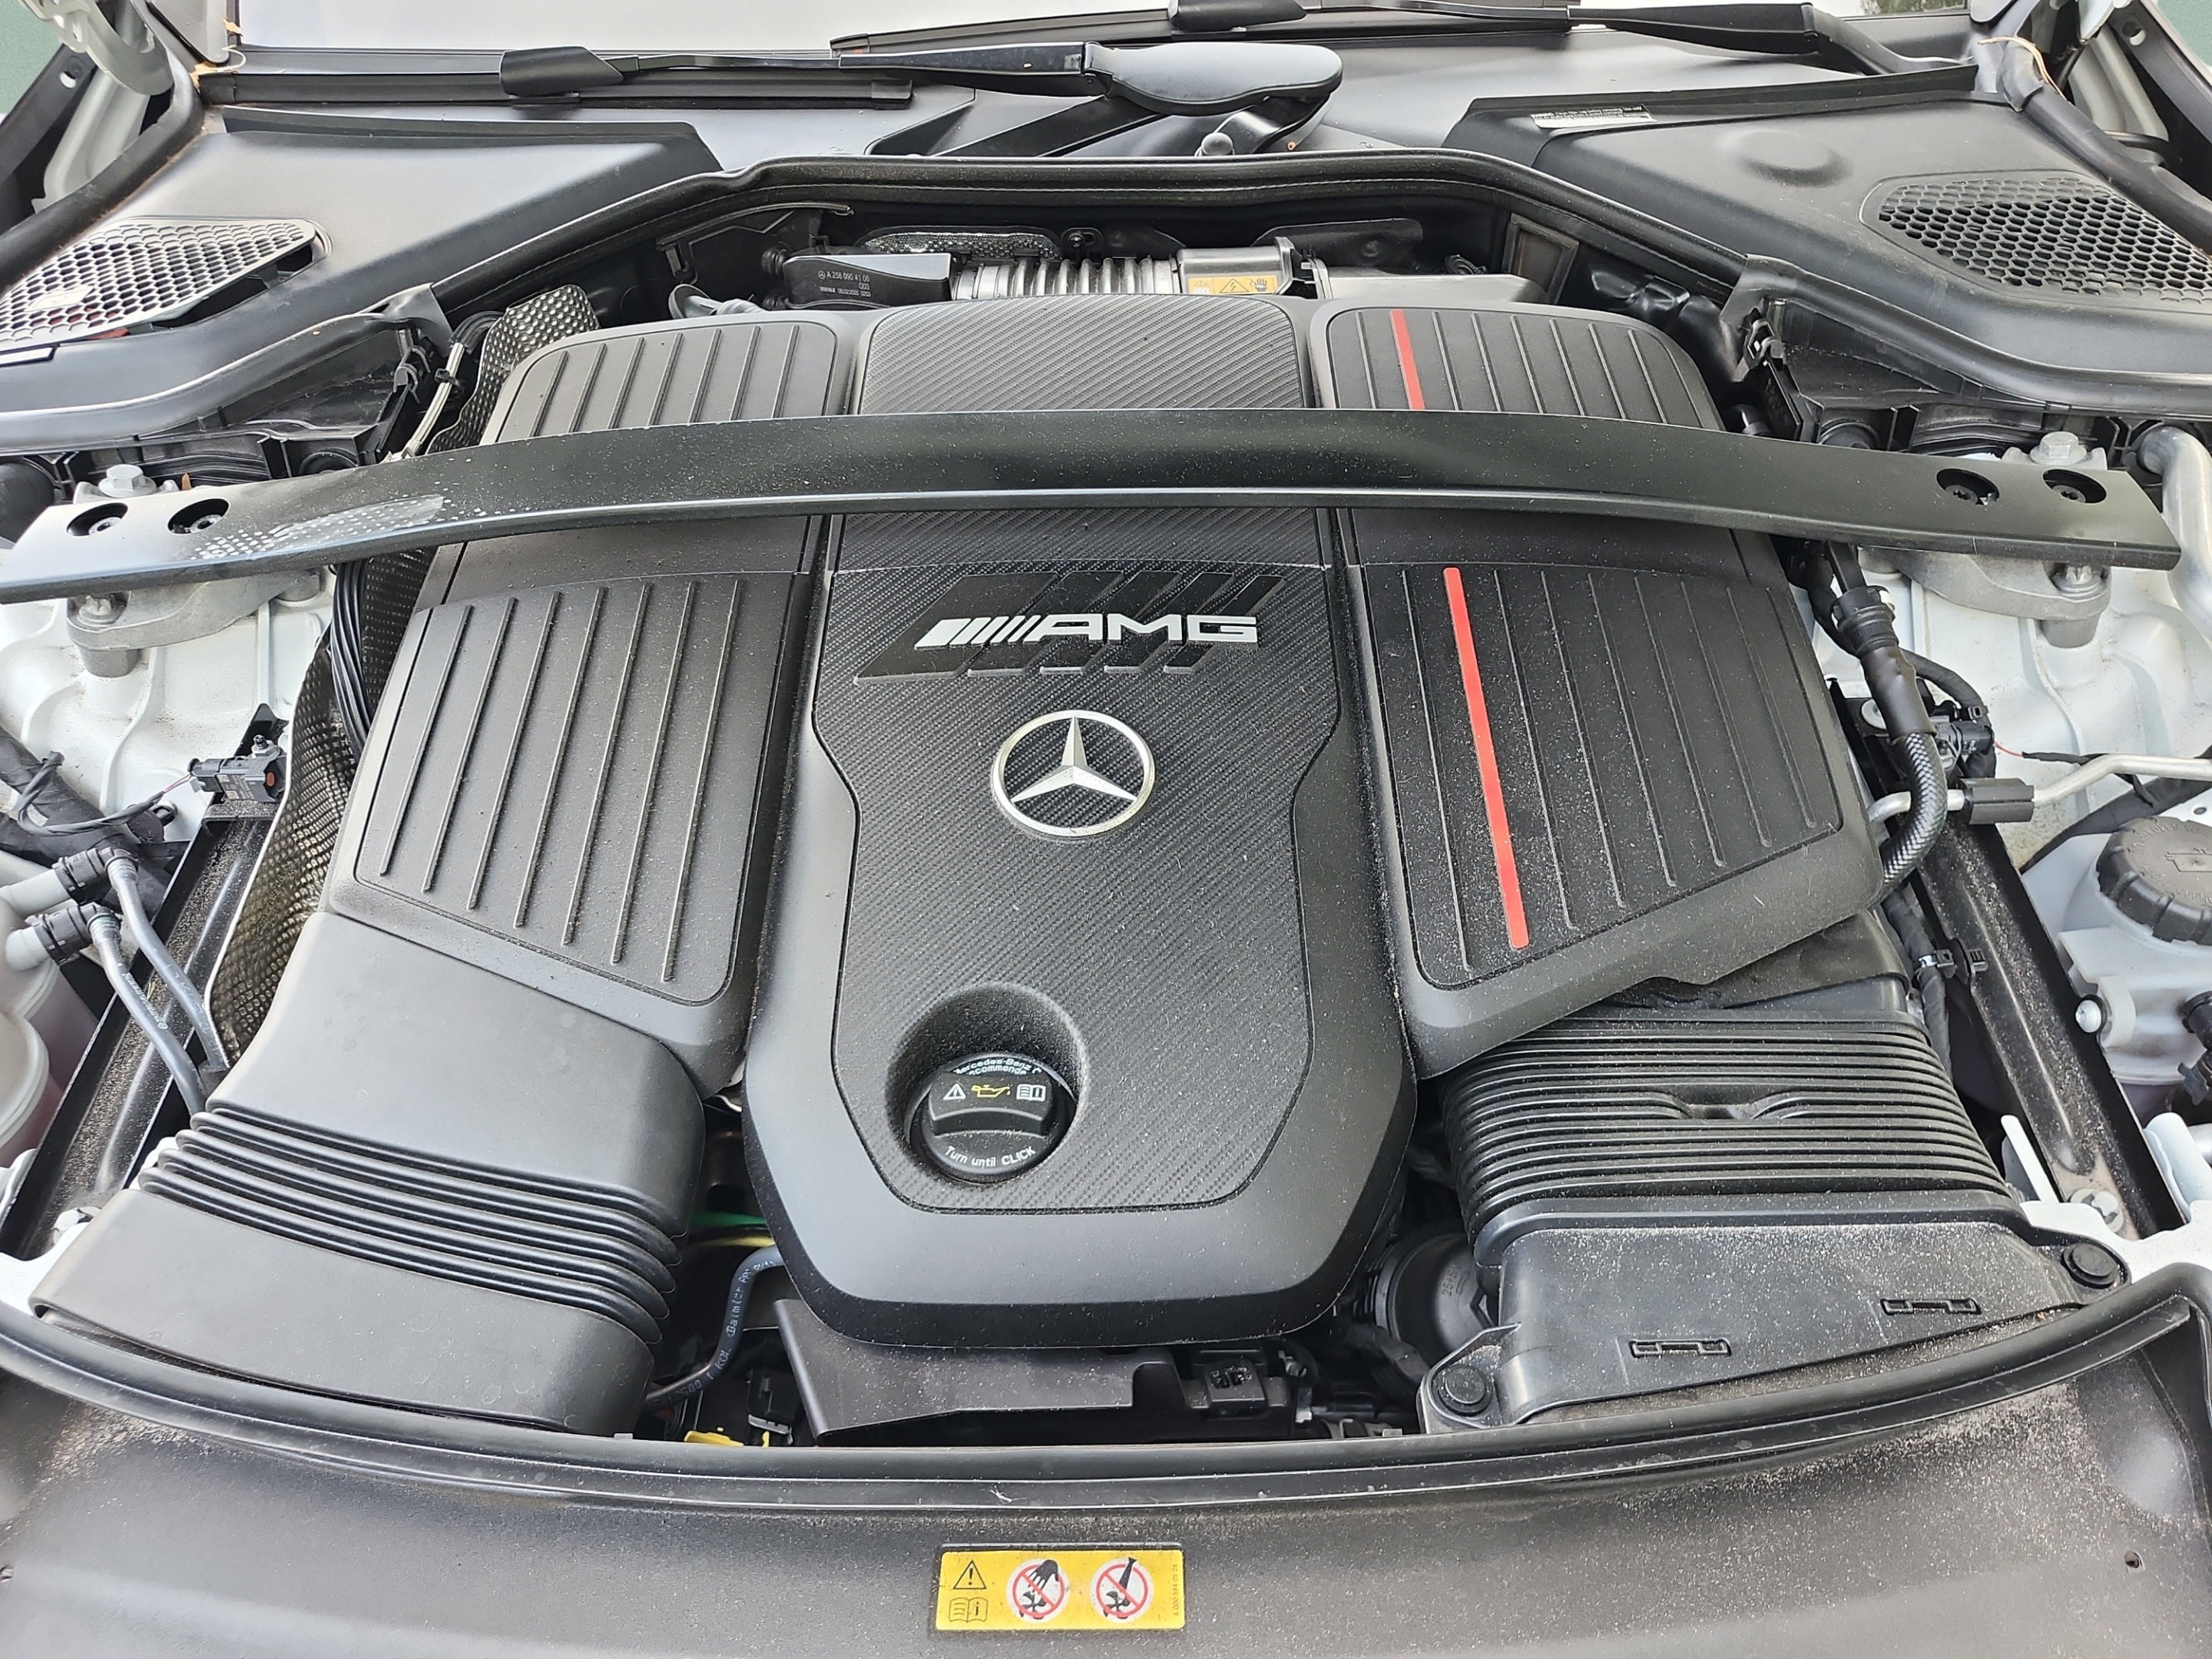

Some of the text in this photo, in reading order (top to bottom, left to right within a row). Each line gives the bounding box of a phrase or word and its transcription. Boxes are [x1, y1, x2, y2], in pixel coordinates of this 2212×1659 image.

[863, 274, 870, 283] 00
[1023, 614, 1257, 644] AMG
[945, 1145, 1036, 1167] Turn until CLICK
